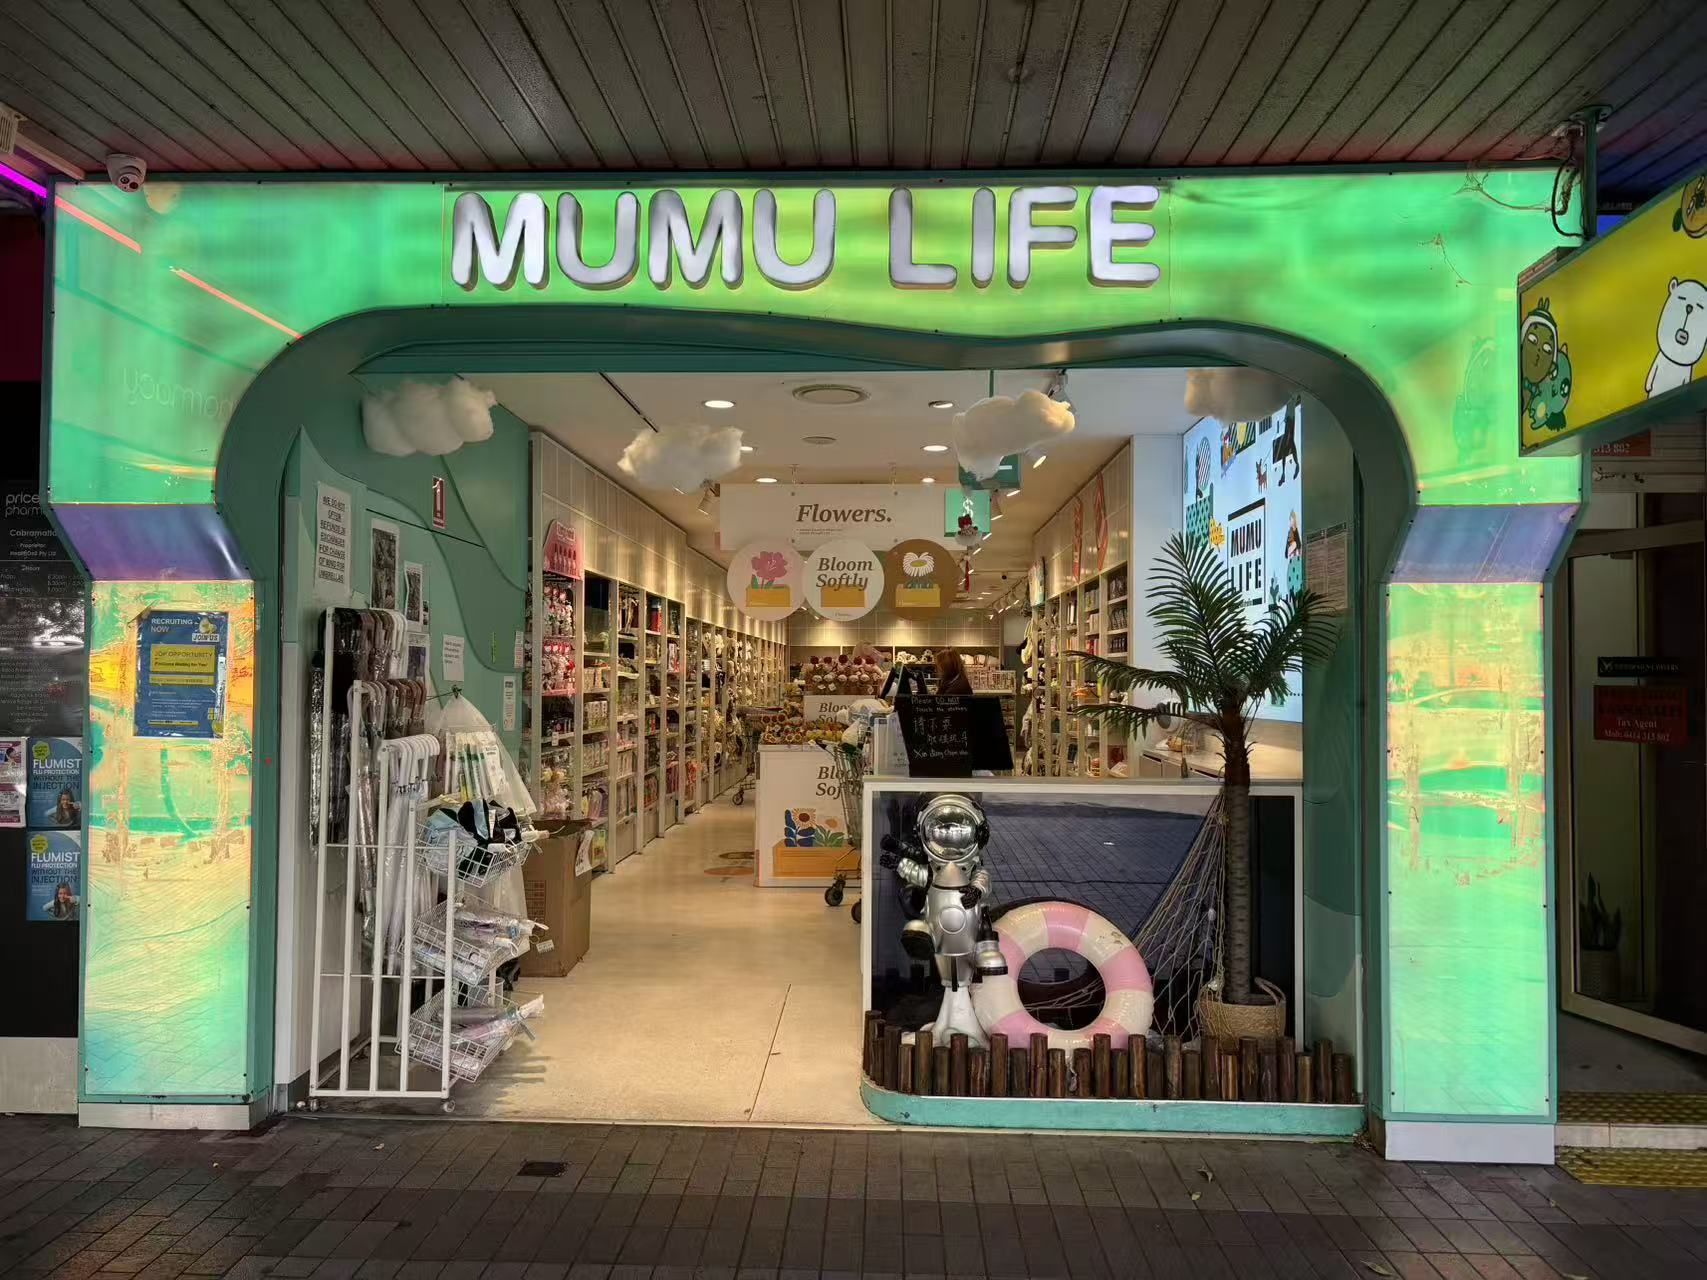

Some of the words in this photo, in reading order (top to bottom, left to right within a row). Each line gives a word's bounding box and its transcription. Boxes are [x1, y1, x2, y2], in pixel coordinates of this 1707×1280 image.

[451, 188, 836, 291] MUMU
[888, 186, 1161, 289] LIFE
[6, 491, 40, 505] price
[795, 503, 893, 523] Flowers.
[1229, 518, 1262, 558] MUMU
[817, 556, 873, 571] Bloom
[815, 572, 868, 591] Softly
[1230, 558, 1262, 592] LIFE
[151, 625, 169, 633] NOW
[1634, 719, 1658, 730] Agent
[33, 758, 82, 769] FLUMIST
[33, 781, 80, 790] INJECTION
[31, 851, 81, 863] FLUMIST
[31, 875, 77, 884] INJECTION
